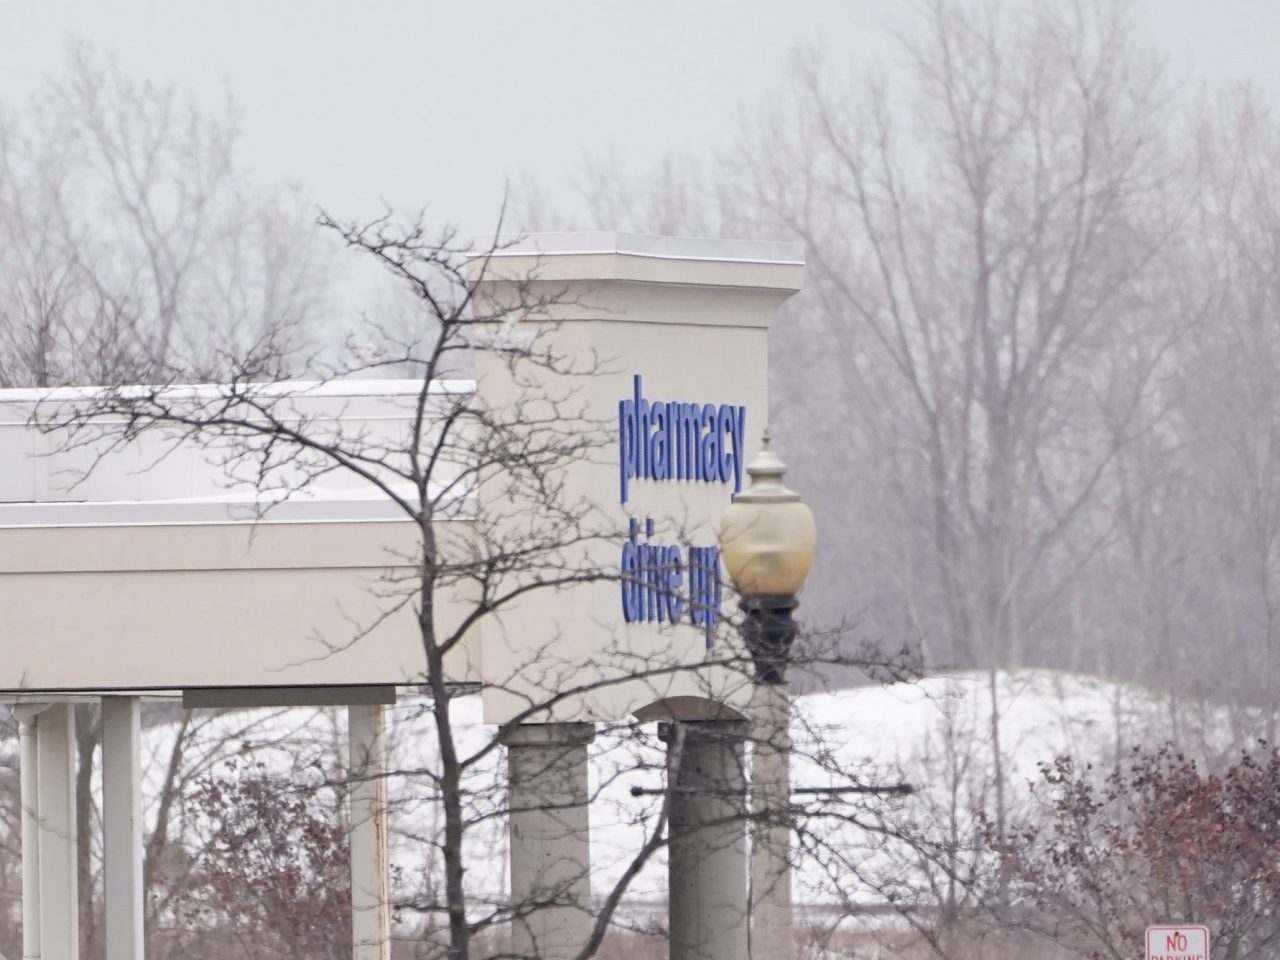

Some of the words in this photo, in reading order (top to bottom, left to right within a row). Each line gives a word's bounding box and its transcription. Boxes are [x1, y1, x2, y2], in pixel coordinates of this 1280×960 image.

[618, 374, 746, 503] pharmacy
[621, 517, 683, 624] drive
[688, 546, 721, 649] up
[1166, 935, 1187, 952] NO
